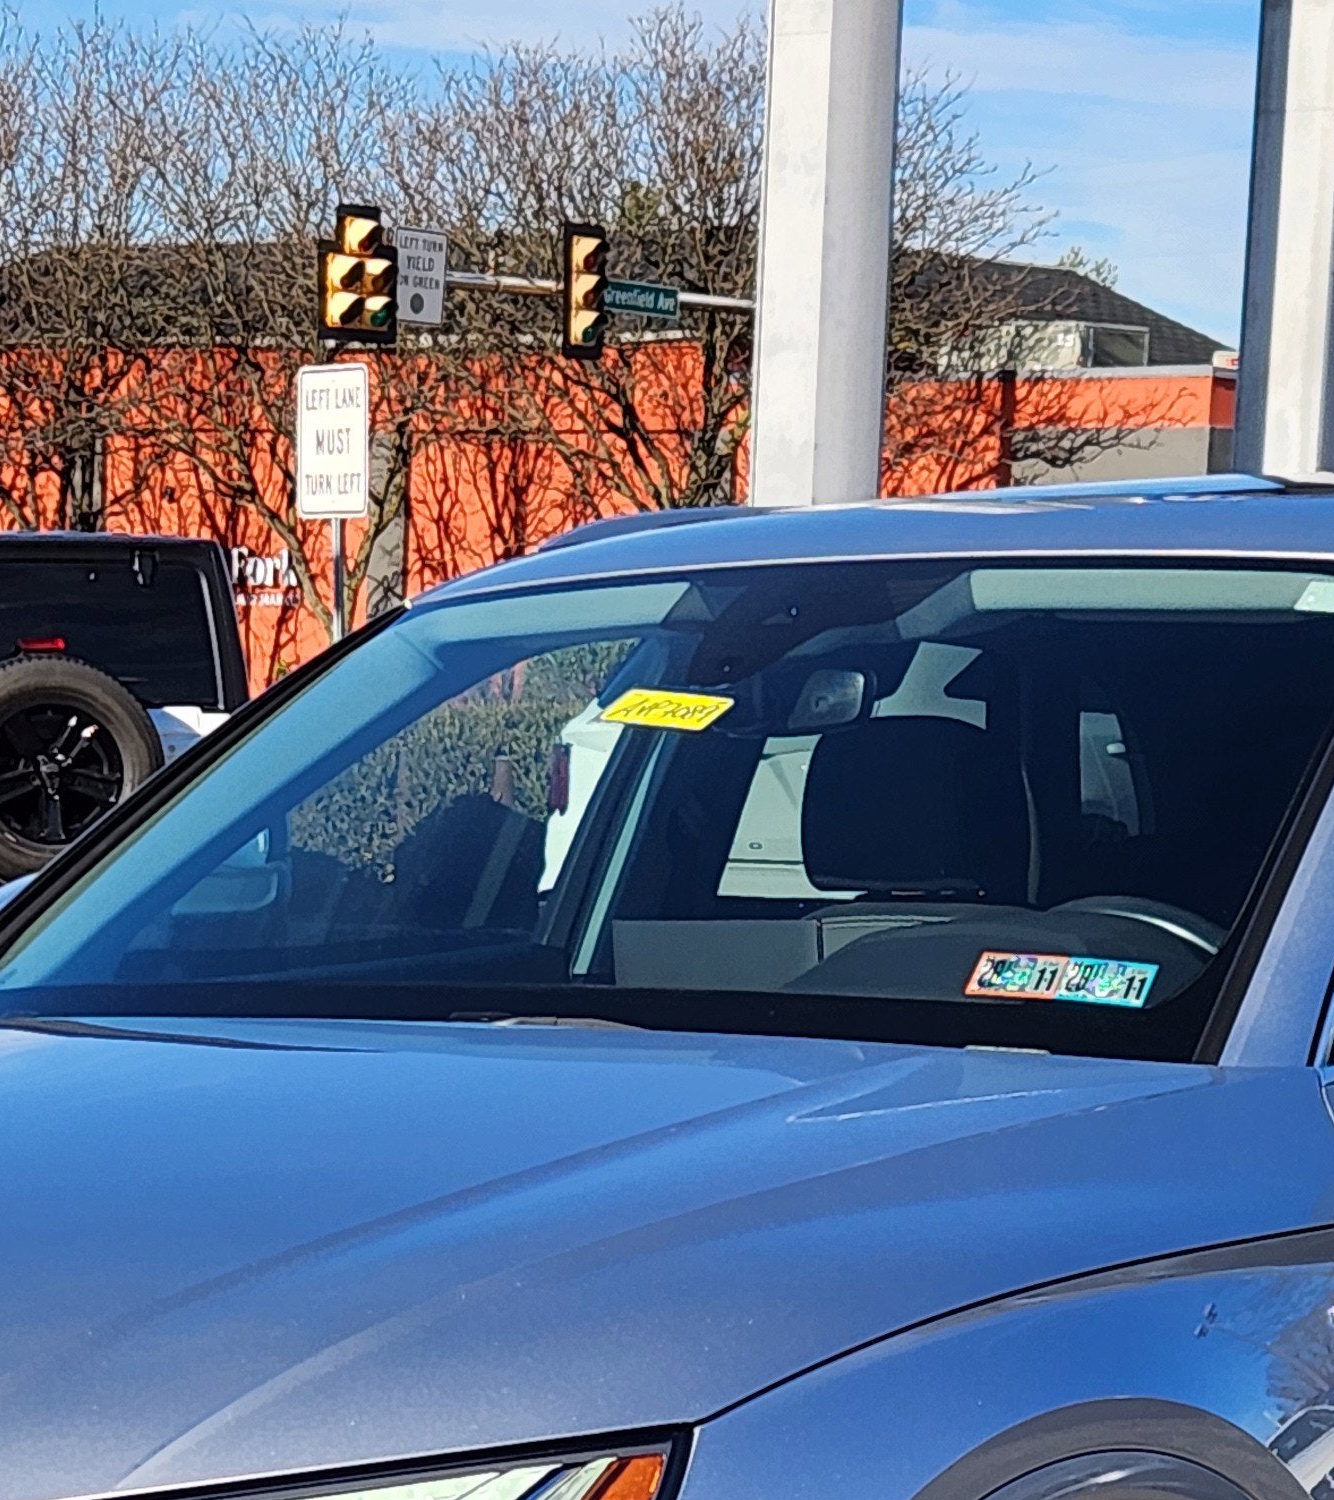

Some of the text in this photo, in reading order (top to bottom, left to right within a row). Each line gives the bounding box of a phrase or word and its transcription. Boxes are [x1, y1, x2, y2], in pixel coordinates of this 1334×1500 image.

[399, 235, 443, 253] LEFT TURN
[406, 255, 435, 271] YIELD
[412, 275, 440, 290] GREEN
[603, 286, 676, 312] Greenfield Ave
[305, 386, 361, 411] LEFT LANE
[315, 427, 351, 456] MUST
[305, 472, 362, 496] TURN LEFT
